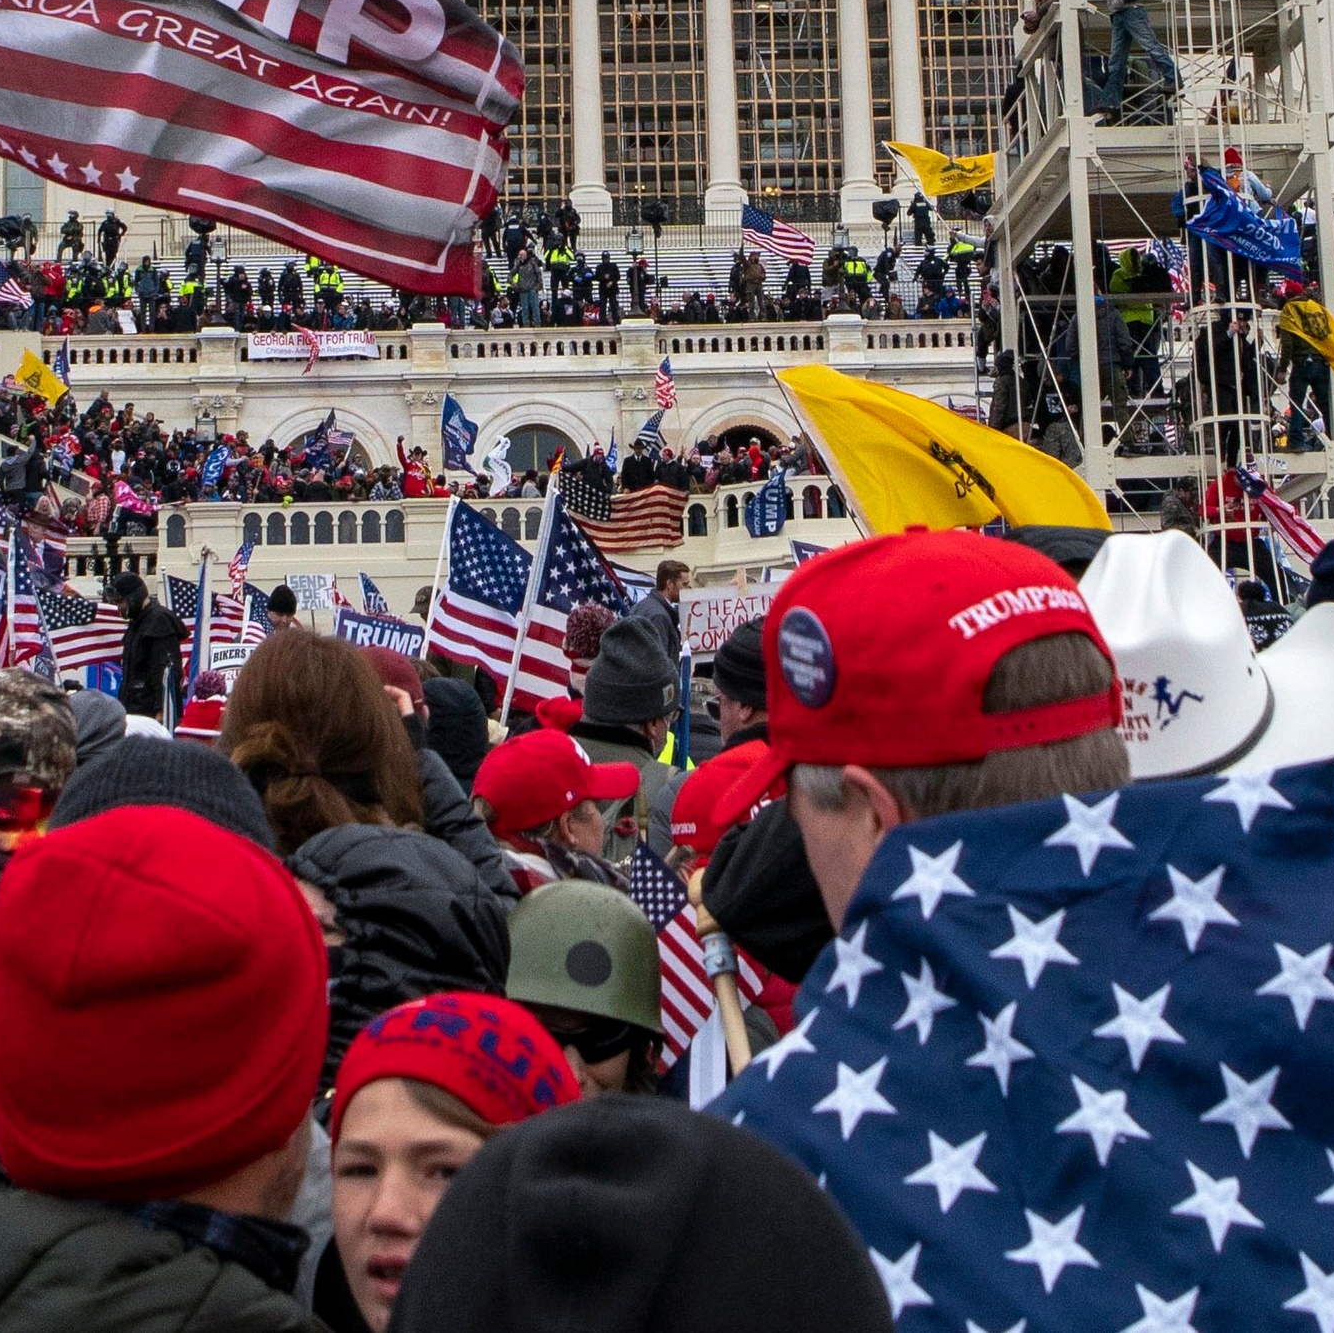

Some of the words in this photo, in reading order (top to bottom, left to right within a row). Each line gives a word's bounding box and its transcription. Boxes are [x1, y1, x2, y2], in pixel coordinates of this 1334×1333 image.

[117, 8, 280, 78] GREAT
[289, 72, 453, 128] AGAIN!
[253, 334, 295, 346] GEORGIA
[327, 334, 346, 345] FOR
[289, 575, 327, 589] SEND
[300, 599, 330, 610] JAIL
[343, 618, 424, 657] TRUMP
[213, 647, 247, 663] BIKERS
